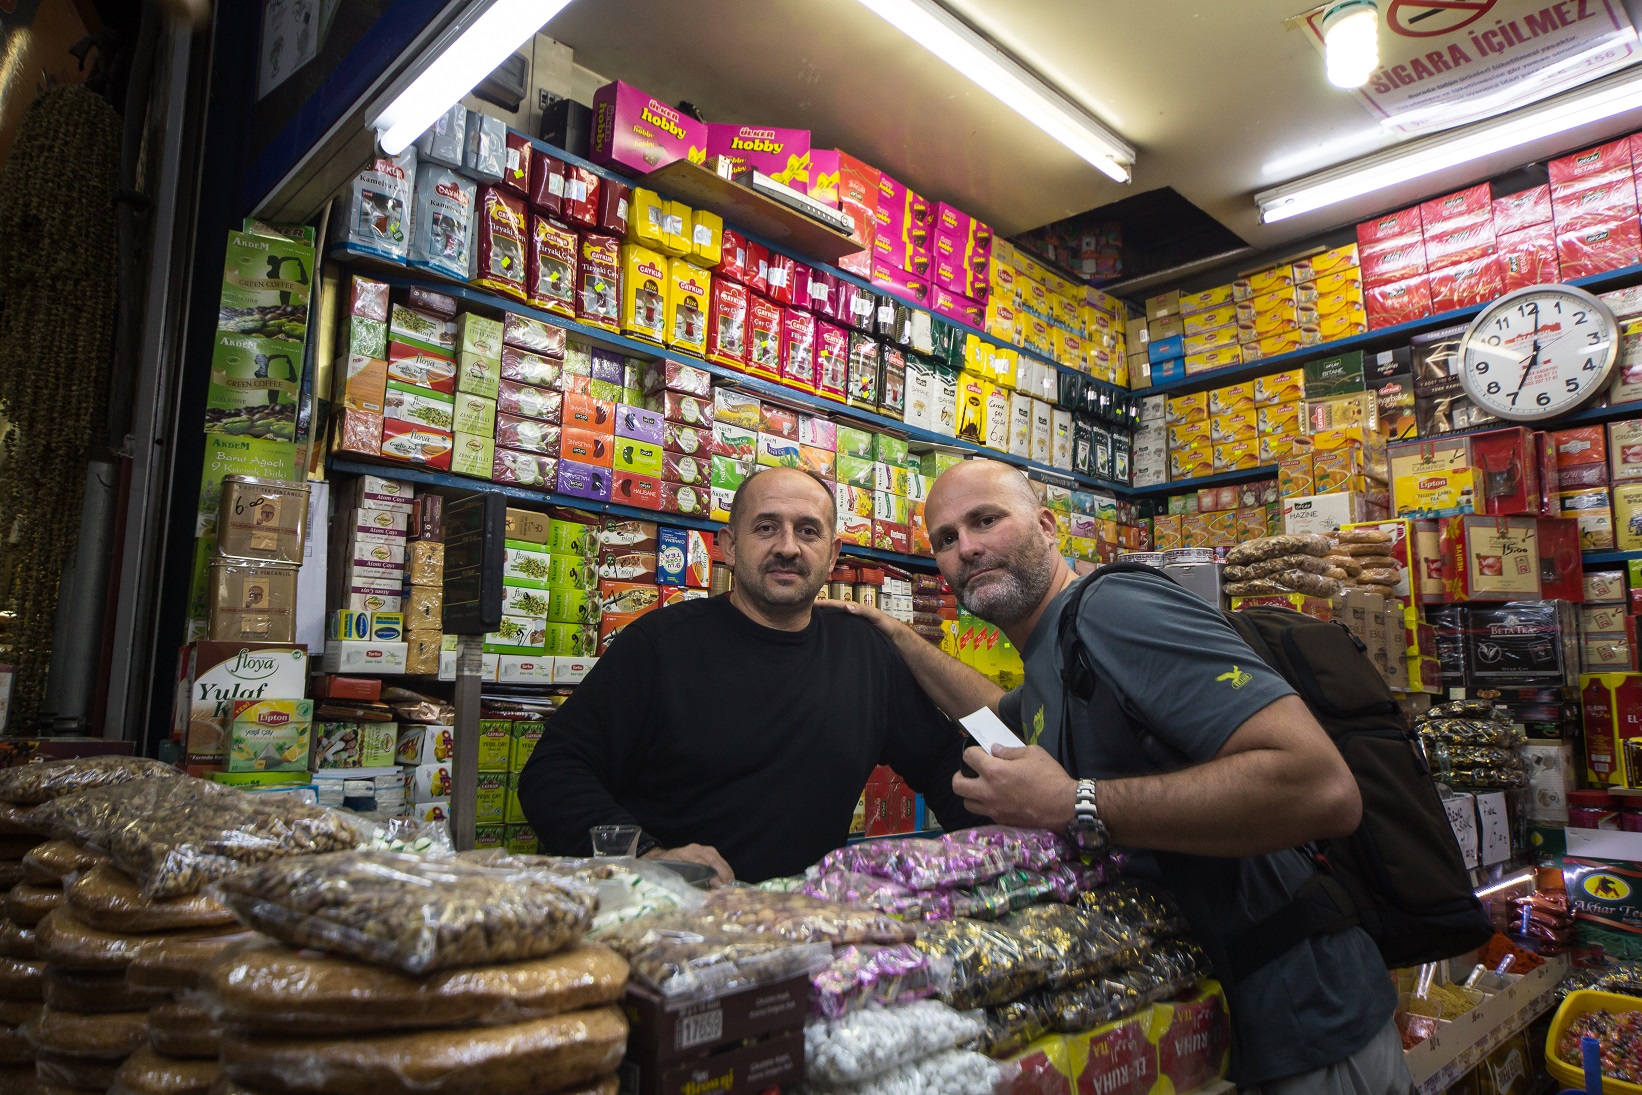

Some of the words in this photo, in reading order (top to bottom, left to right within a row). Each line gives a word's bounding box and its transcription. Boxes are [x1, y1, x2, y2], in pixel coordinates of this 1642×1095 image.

[1369, 43, 1473, 95] SİGARA
[1468, 0, 1596, 58] İÇİLMEZ
[1585, 50, 1616, 67] 156
[649, 99, 679, 123] ÜLKER
[640, 107, 687, 140] hobby
[740, 127, 775, 139] ÜLKER
[730, 136, 785, 154] hobby
[238, 278, 265, 288] GREEN
[265, 280, 295, 290] COFFEE
[1518, 302, 1540, 318] 12
[1553, 301, 1562, 314] 1
[1495, 316, 1510, 331] 11
[1572, 311, 1588, 325] 2
[1587, 331, 1601, 346] 3
[1475, 361, 1489, 375] 9
[1582, 357, 1597, 371] 4
[226, 379, 252, 388] GREEN
[253, 380, 283, 388] COFFEE
[1487, 381, 1501, 395] 8
[1565, 377, 1580, 392] 5
[1506, 391, 1519, 406] 7
[1536, 392, 1552, 406] 6
[211, 438, 250, 451] AKDEM
[1420, 478, 1446, 489] Lipton
[1490, 625, 1515, 636] BETA
[230, 647, 275, 673] floya
[199, 682, 268, 701] Yulaf
[259, 713, 288, 722] Lipton
[1573, 899, 1617, 915] Akhar
